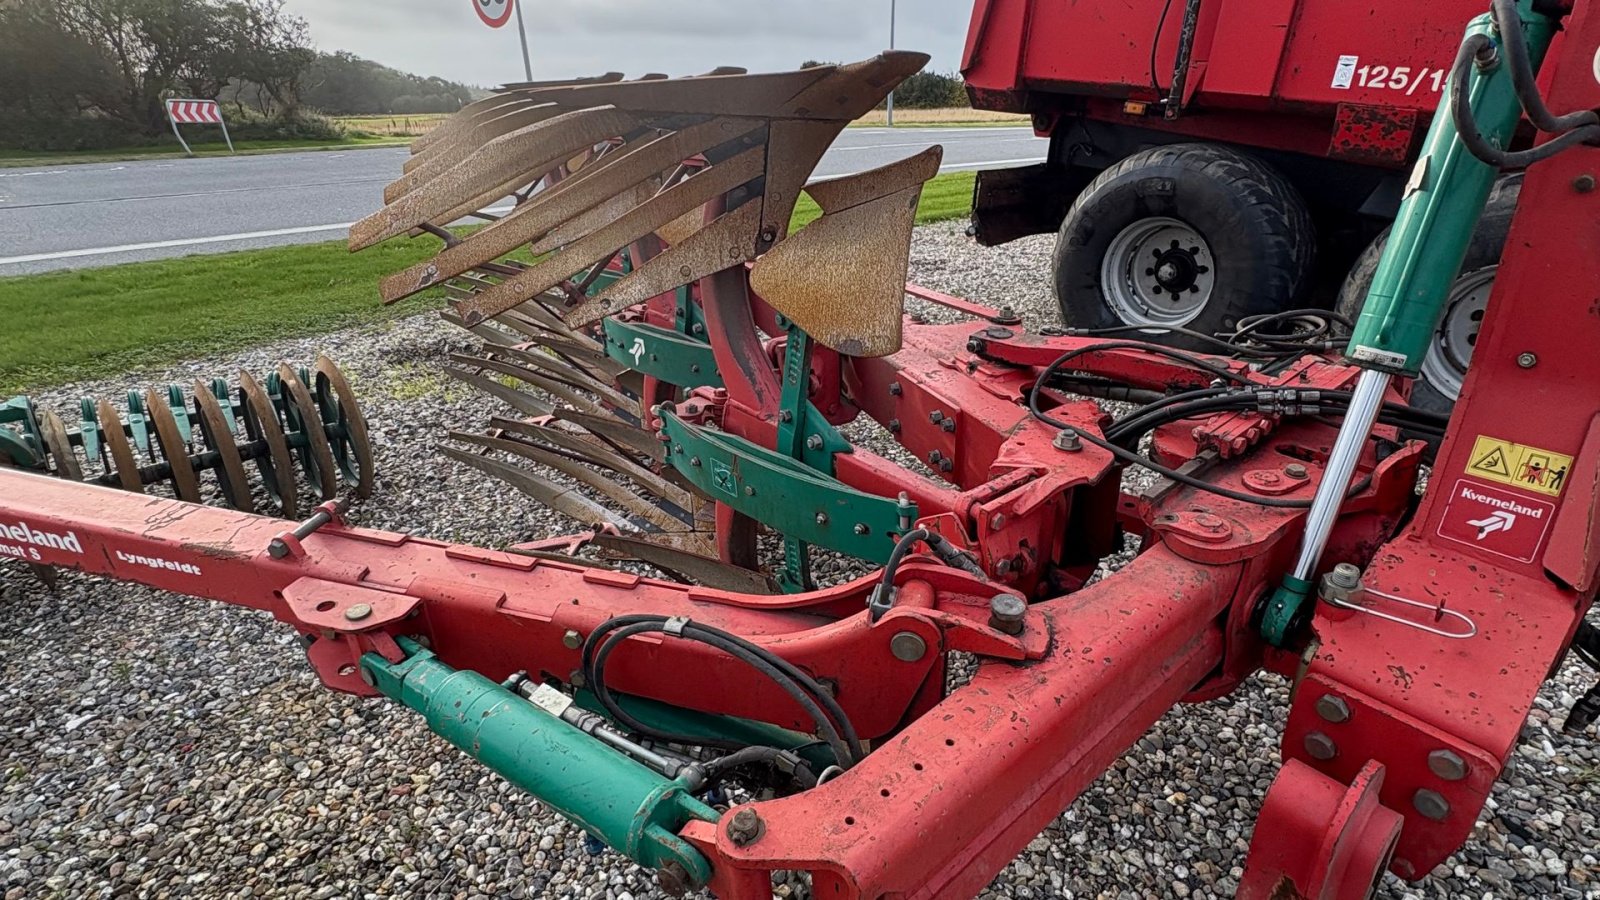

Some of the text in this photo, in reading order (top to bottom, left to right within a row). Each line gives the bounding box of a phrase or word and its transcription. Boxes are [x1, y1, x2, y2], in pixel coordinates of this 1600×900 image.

[1357, 65, 1450, 96] 125/1
[1460, 487, 1543, 519] Kverneland
[28, 547, 42, 561] S
[115, 550, 202, 576] Lyngfeldt
